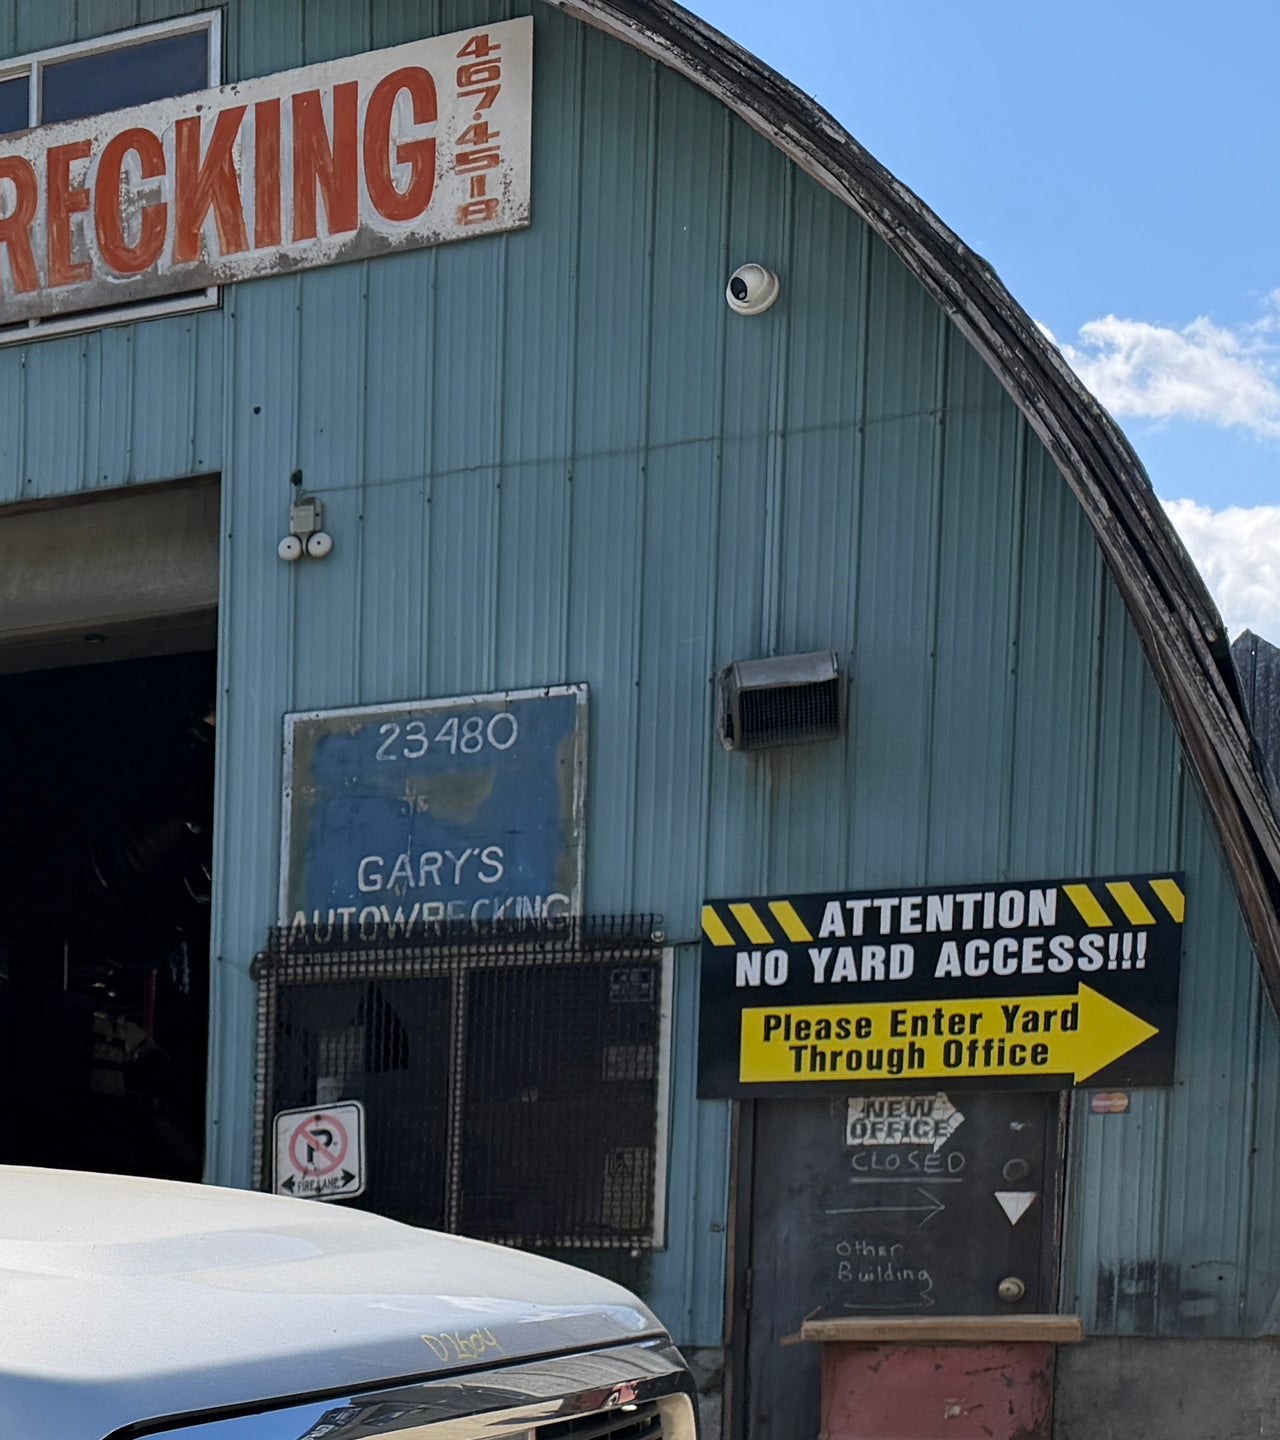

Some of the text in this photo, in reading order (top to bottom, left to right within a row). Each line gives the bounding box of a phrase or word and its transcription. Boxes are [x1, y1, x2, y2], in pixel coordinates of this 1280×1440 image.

[375, 712, 519, 761] 23480
[357, 846, 505, 893] GARY'S
[818, 888, 1058, 939] ATTENTION
[735, 931, 1148, 988] NO YARD ACCESS!!!
[763, 1003, 1080, 1043] Please Enter Yard
[789, 1038, 1050, 1076] Through Office
[865, 1099, 934, 1117] NEW
[850, 1118, 949, 1140] OFFICE
[851, 1151, 965, 1174] CLOSED
[836, 1240, 903, 1257] Other
[838, 1261, 935, 1291] Building
